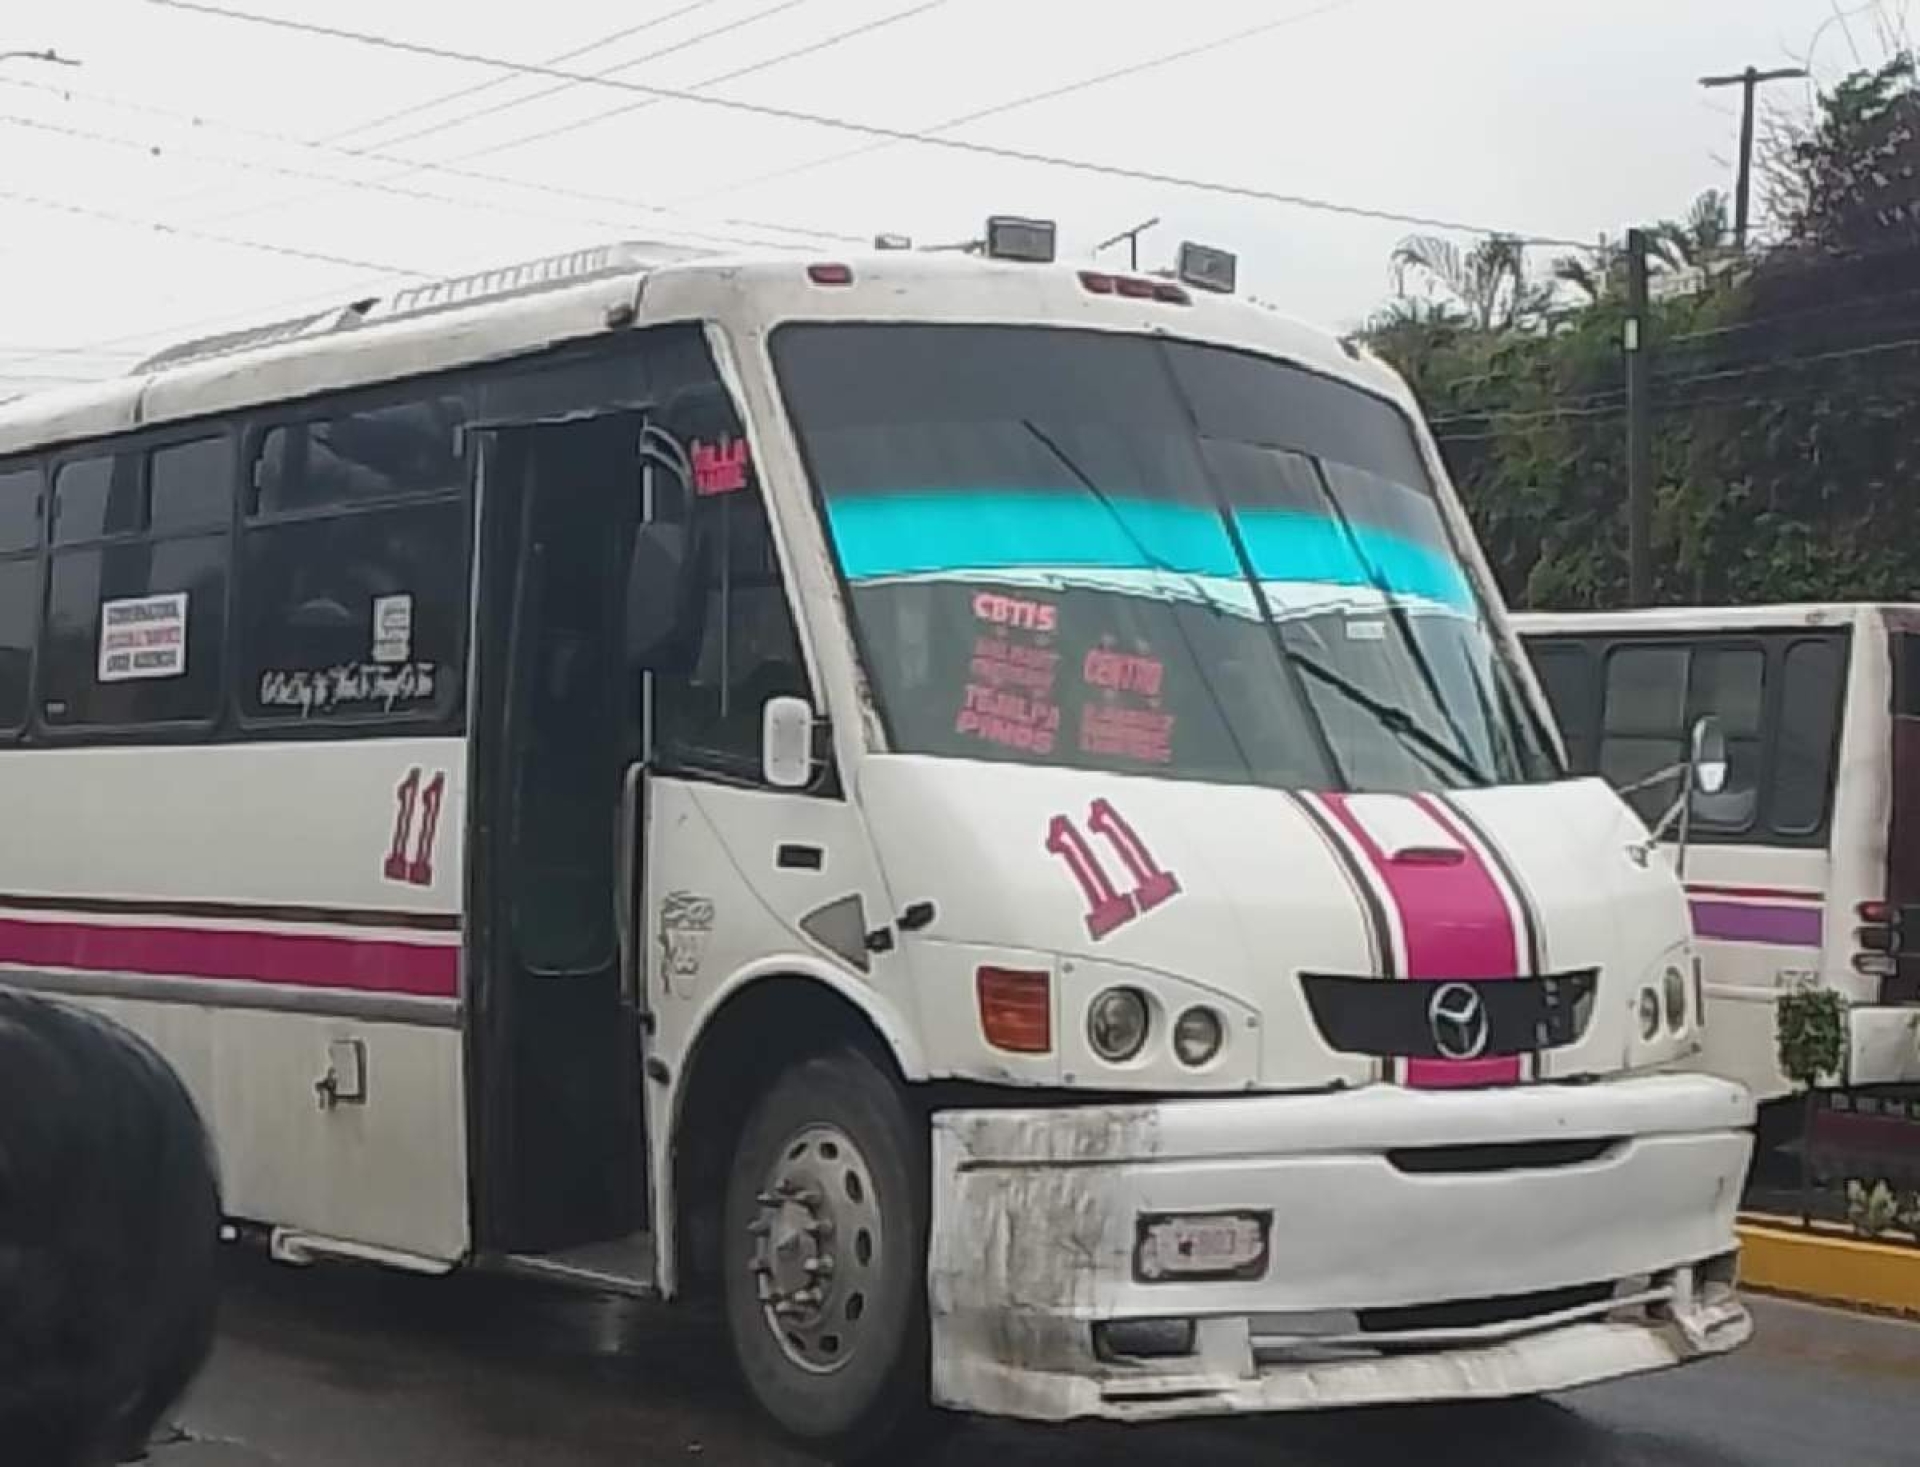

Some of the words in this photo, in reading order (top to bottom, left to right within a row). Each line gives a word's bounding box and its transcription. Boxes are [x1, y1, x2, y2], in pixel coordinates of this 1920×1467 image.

[972, 592, 1058, 632] CBTIS
[383, 766, 445, 887] 11
[1045, 797, 1183, 942] 11
